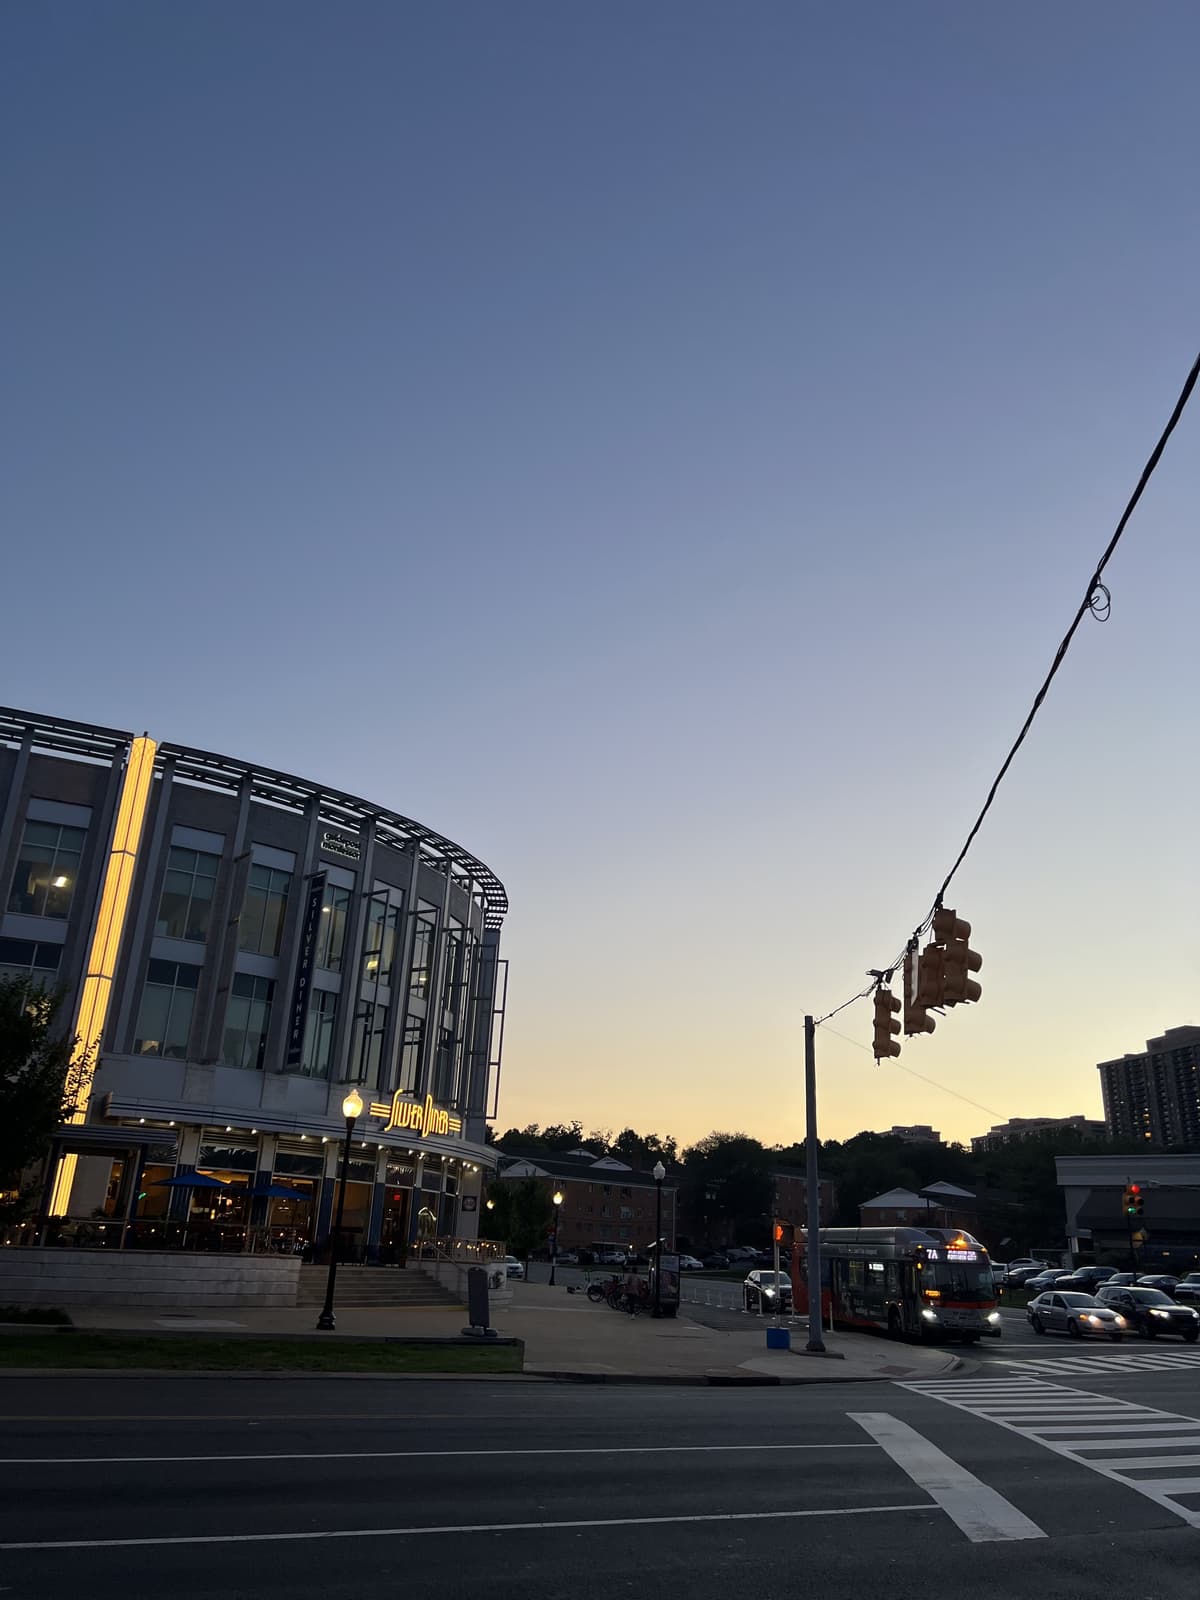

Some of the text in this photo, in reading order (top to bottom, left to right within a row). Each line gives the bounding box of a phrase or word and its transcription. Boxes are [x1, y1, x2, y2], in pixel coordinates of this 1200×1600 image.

[293, 897, 318, 1040] SILVER DINER
[926, 1249, 939, 1260] 7A
